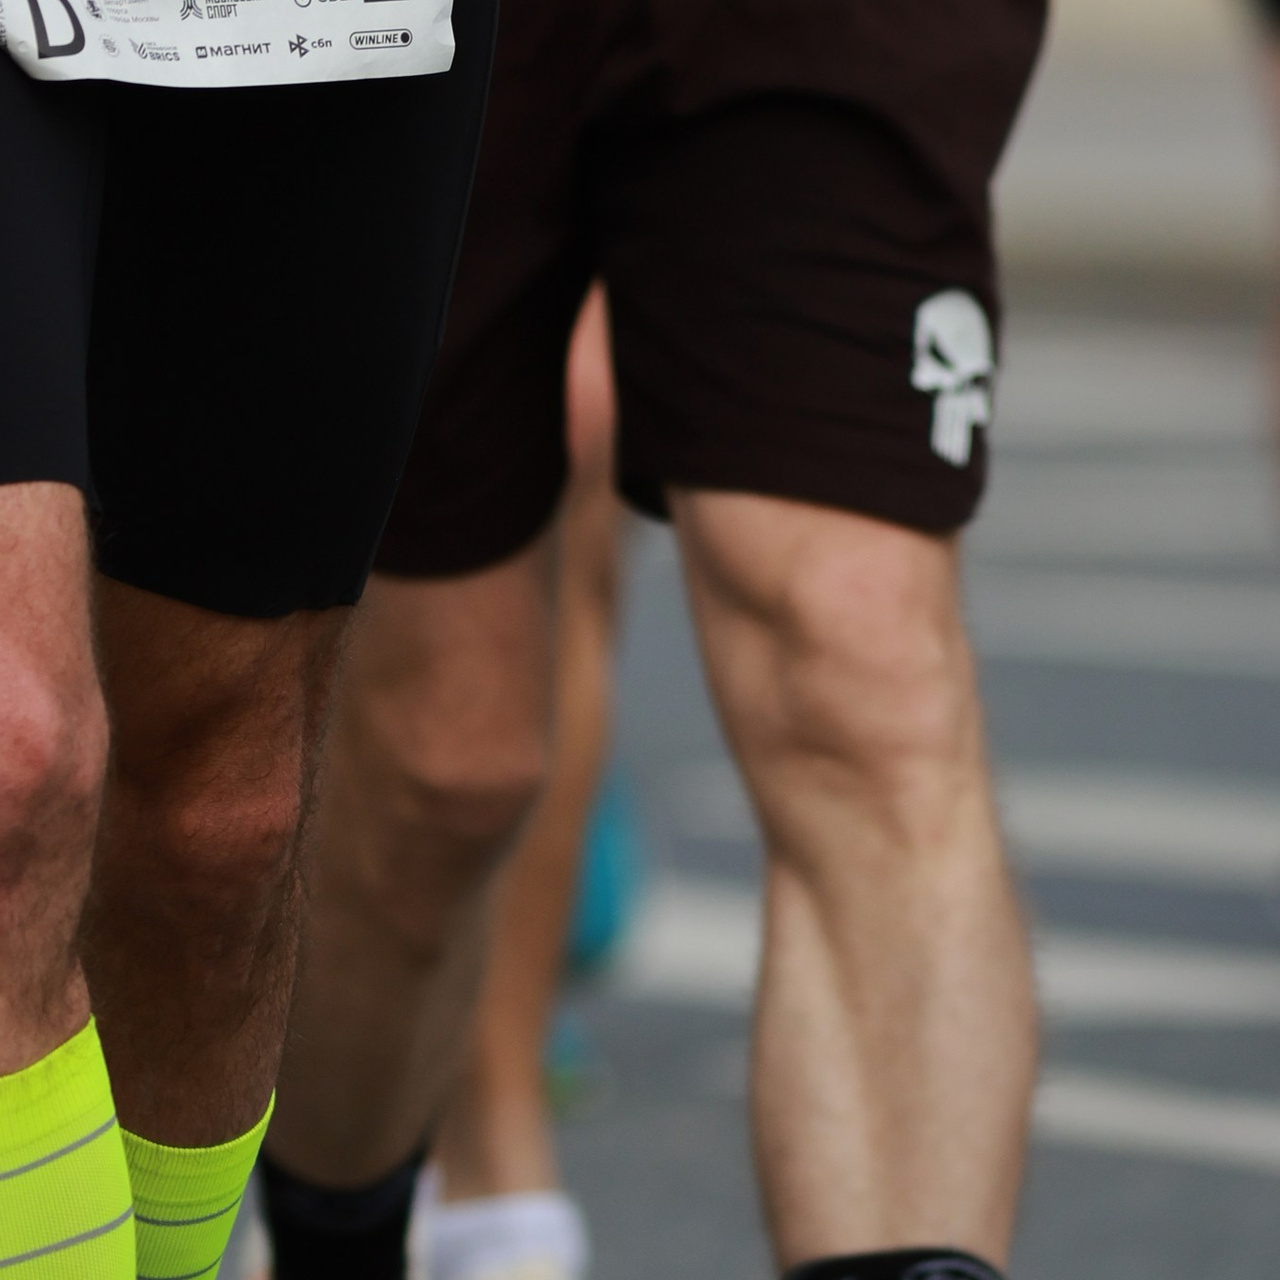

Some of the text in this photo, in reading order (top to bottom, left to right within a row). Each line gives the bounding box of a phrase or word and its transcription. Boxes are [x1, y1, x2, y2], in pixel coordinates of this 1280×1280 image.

[207, 4, 238, 19] СПОРТ
[354, 32, 399, 46] WINLINE
[148, 50, 181, 62] BRICS
